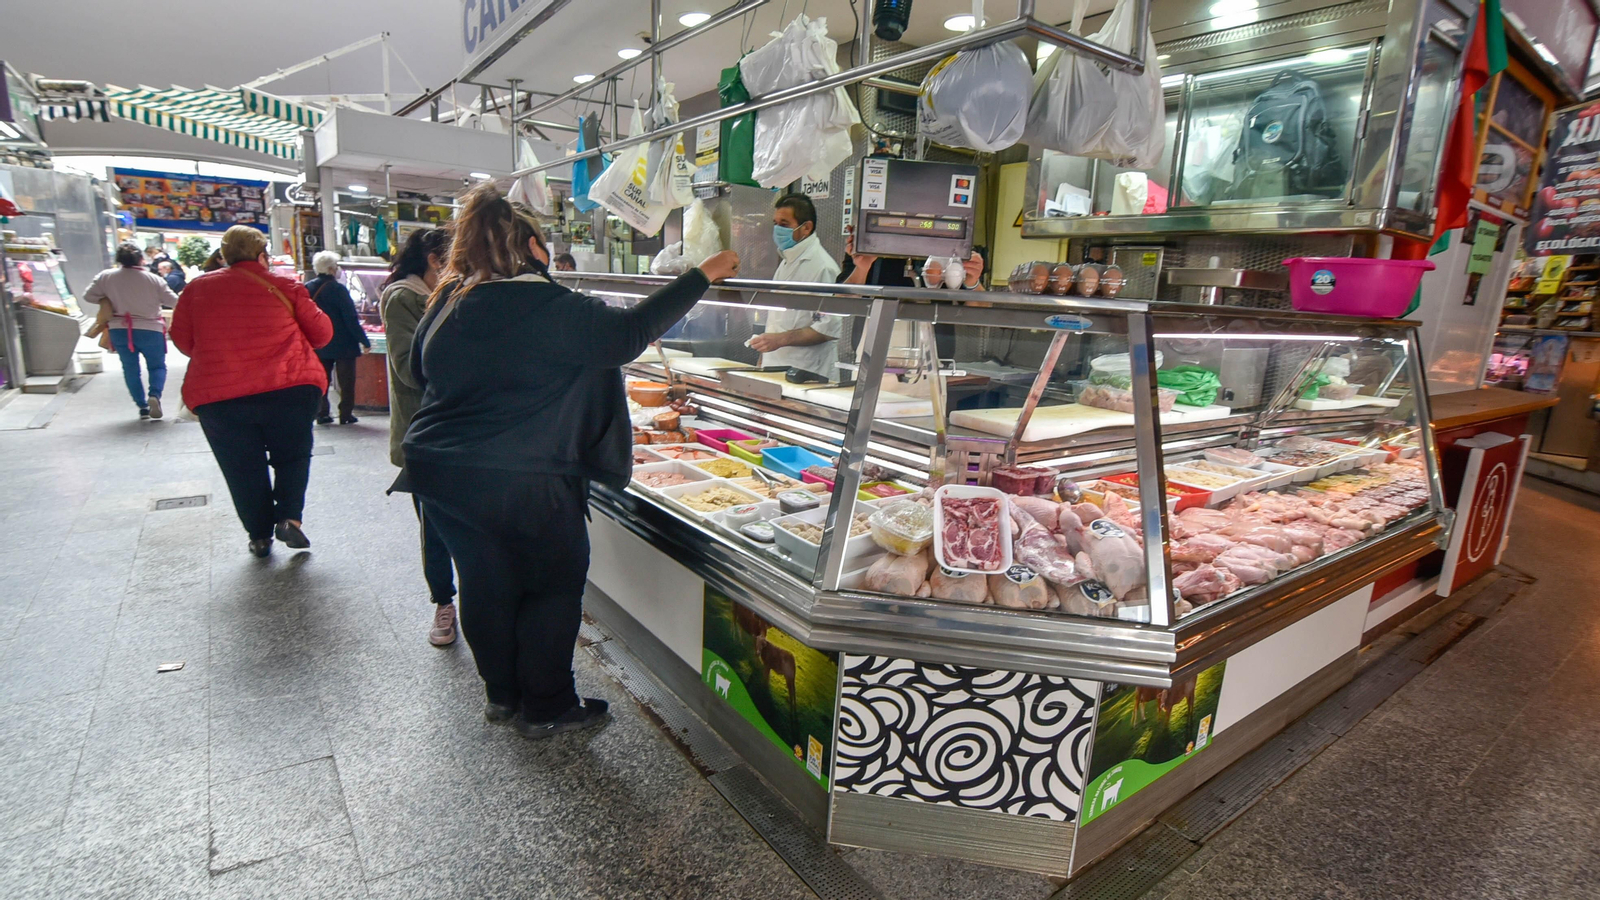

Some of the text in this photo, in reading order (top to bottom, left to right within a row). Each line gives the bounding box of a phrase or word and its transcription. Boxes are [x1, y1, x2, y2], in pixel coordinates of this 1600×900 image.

[627, 182, 642, 196] SUR
[623, 189, 647, 209] CANAL
[1316, 274, 1330, 284] 20
